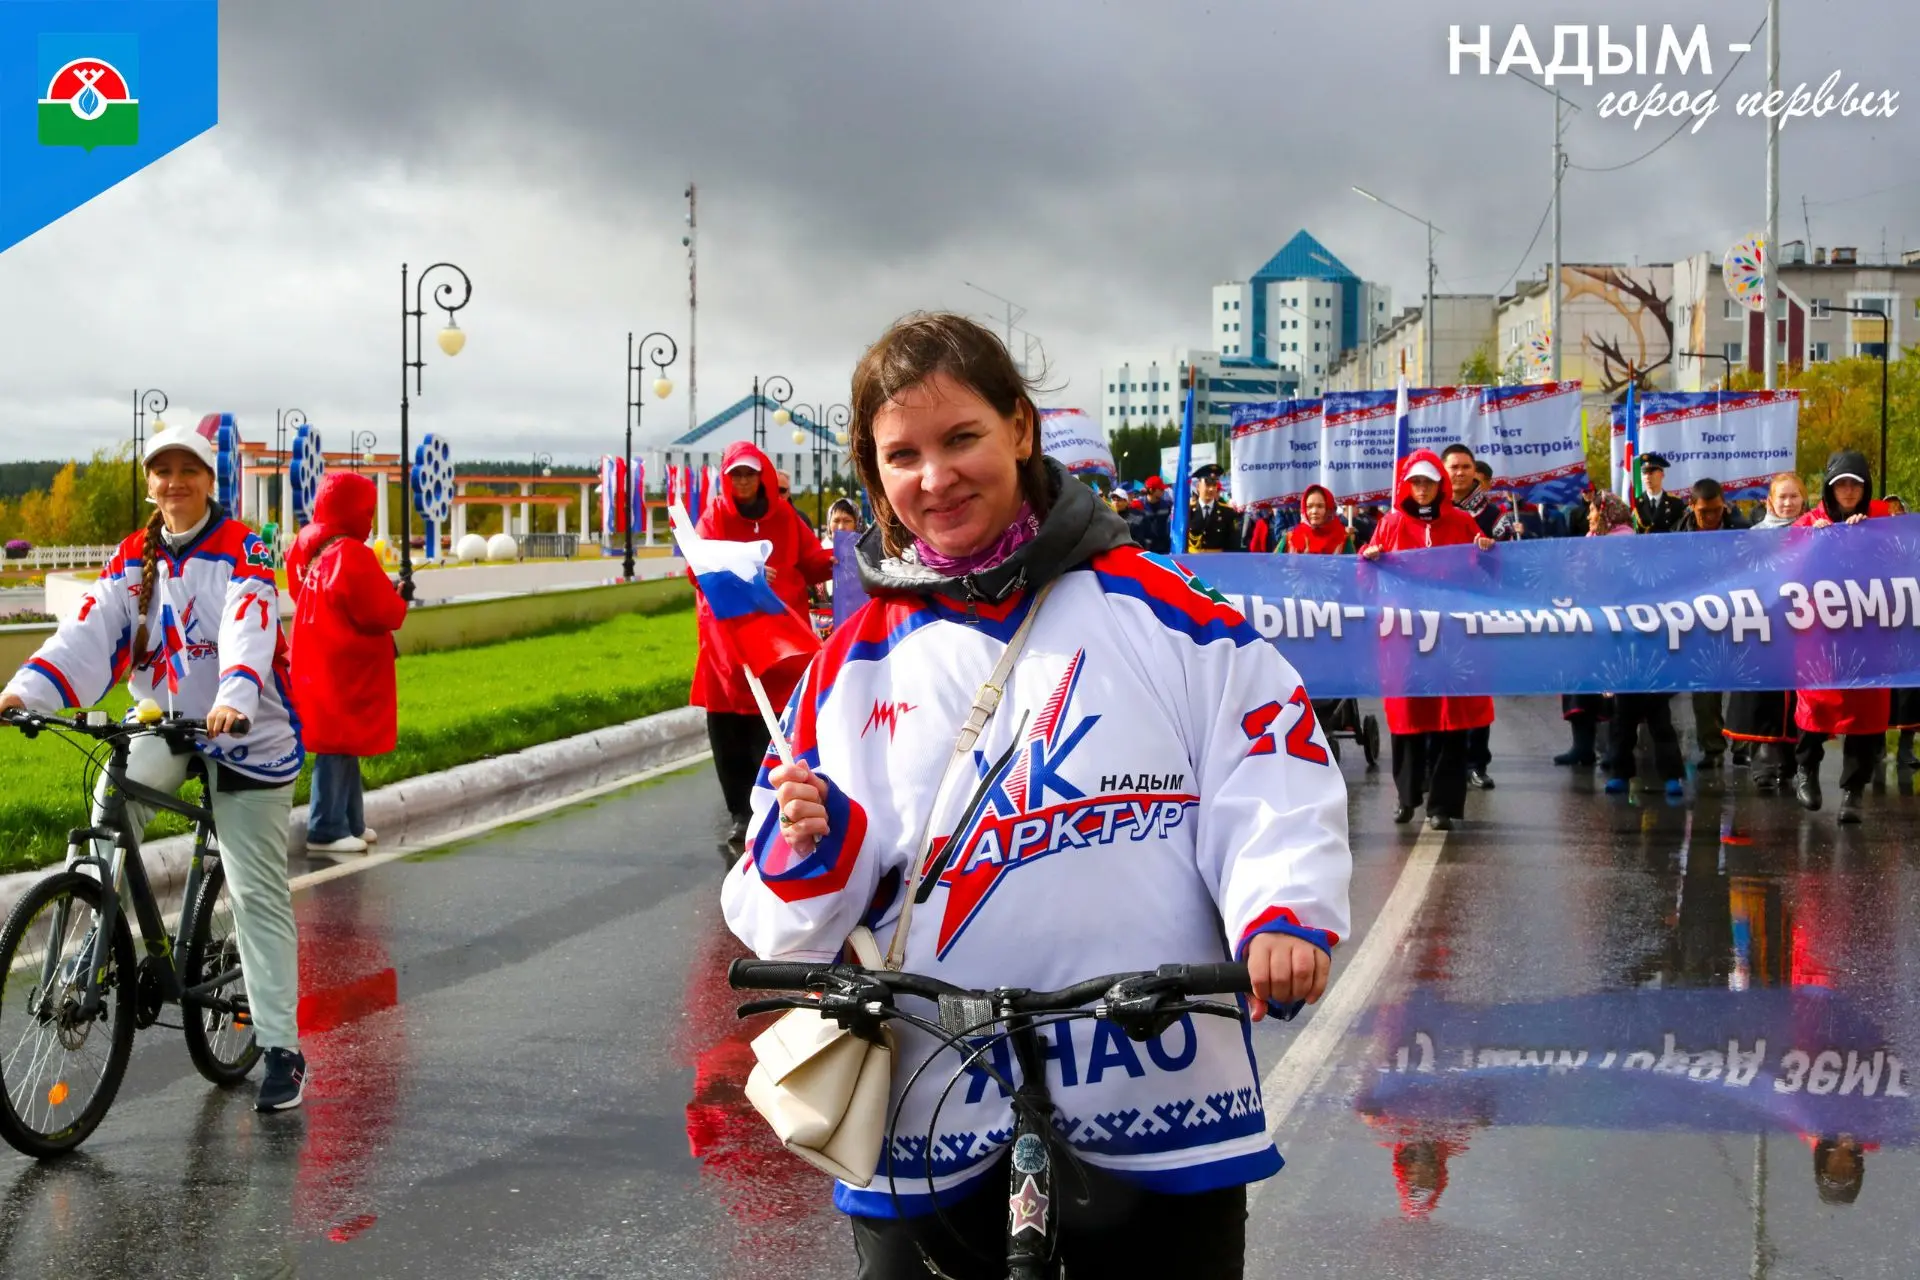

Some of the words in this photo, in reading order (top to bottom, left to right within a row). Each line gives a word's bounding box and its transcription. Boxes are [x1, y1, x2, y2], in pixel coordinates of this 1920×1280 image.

[1288, 440, 1318, 453] Трест
[1701, 431, 1736, 444] Трест
[1600, 588, 1771, 650] город
[1100, 773, 1185, 794] НАДЫМ
[961, 800, 1185, 875] АРКТУР
